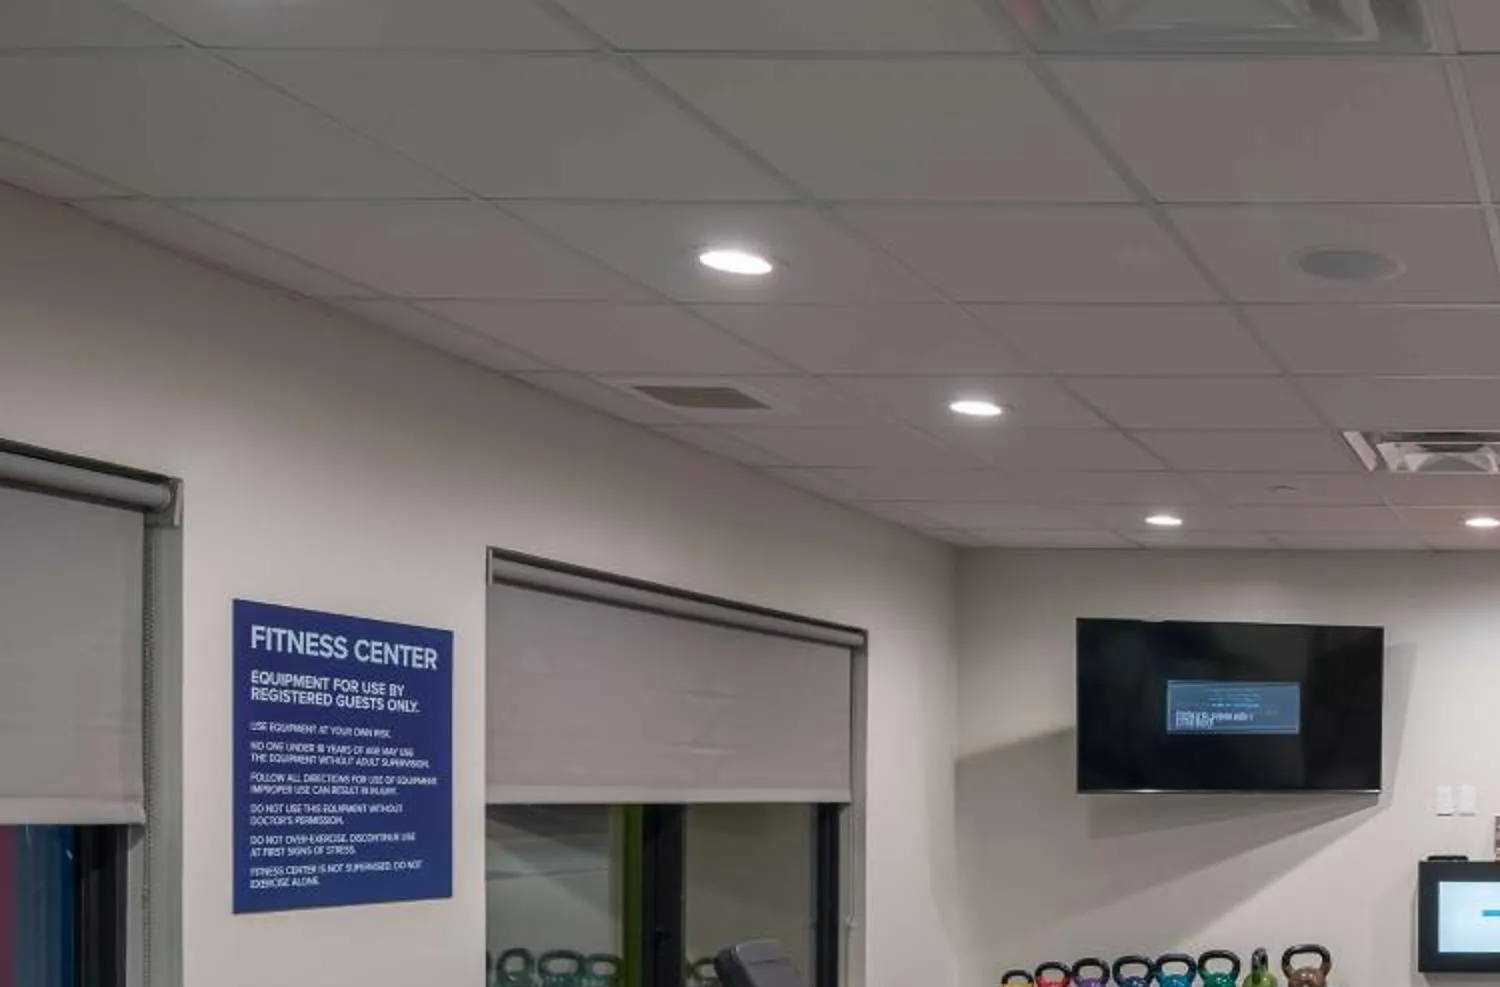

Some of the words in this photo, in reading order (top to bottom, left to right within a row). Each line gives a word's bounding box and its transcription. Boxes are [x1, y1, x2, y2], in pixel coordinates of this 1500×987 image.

[251, 624, 349, 660] FITNESS
[354, 638, 438, 671] CENTER
[251, 669, 330, 691] EQUIPMENT
[333, 678, 359, 694] FOR
[362, 681, 386, 696] USE
[389, 683, 405, 698] BY
[251, 687, 332, 707] REGISTERED
[335, 694, 385, 711] GUESTS
[387, 699, 421, 714] ONLY.
[269, 721, 317, 734] EQUIPMENT
[330, 726, 352, 736] YOUR
[354, 727, 373, 737] OWN
[250, 741, 264, 751] NO
[266, 741, 284, 752] ONE
[285, 743, 315, 753] UNDER
[251, 752, 267, 763] THE
[269, 752, 317, 765] EQUIPMENT
[318, 755, 354, 766] WITHOUT
[355, 757, 380, 767] ADULT
[250, 771, 285, 783] FOLLOW
[286, 773, 301, 783] ALL
[303, 773, 350, 784] DIRECTIONS
[351, 775, 367, 784] FOR
[250, 784, 293, 795] IMPROPER
[312, 785, 331, 795] CAN
[250, 803, 264, 813] DO
[266, 803, 284, 813] NOT
[323, 803, 367, 814] EQUIPMENT
[250, 835, 264, 845] DO
[266, 835, 283, 845] NOT
[251, 847, 262, 857] AT
[287, 845, 312, 857] SIGNS
[285, 865, 317, 875] CENTER
[327, 863, 344, 873] NOT
